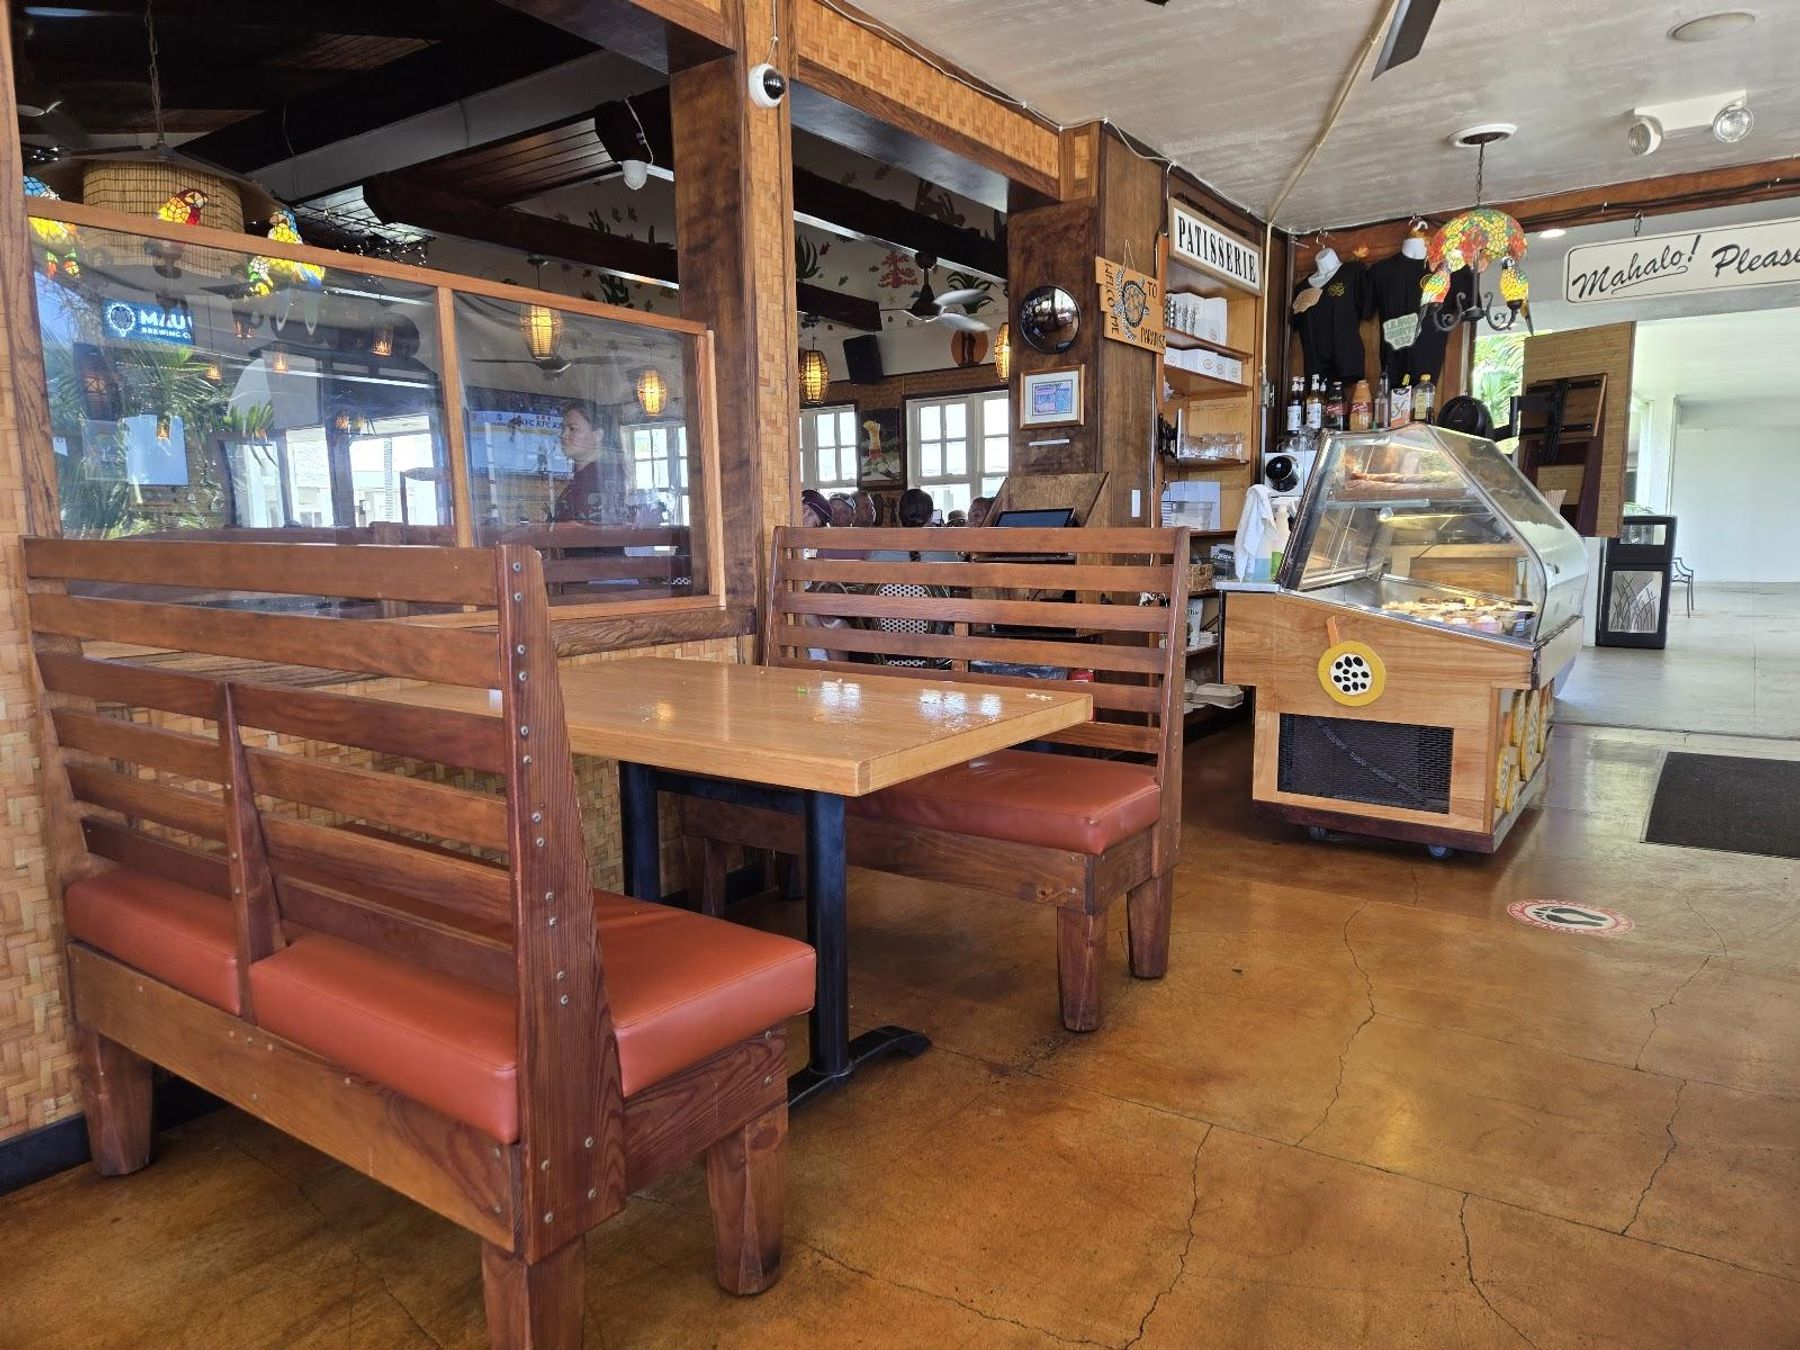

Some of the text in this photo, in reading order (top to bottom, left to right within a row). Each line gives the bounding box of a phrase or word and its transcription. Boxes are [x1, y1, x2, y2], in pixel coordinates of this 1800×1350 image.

[1177, 215, 1257, 284] PATISSERIE
[1571, 234, 1702, 299] Mahalo!
[1147, 281, 1158, 299] TO
